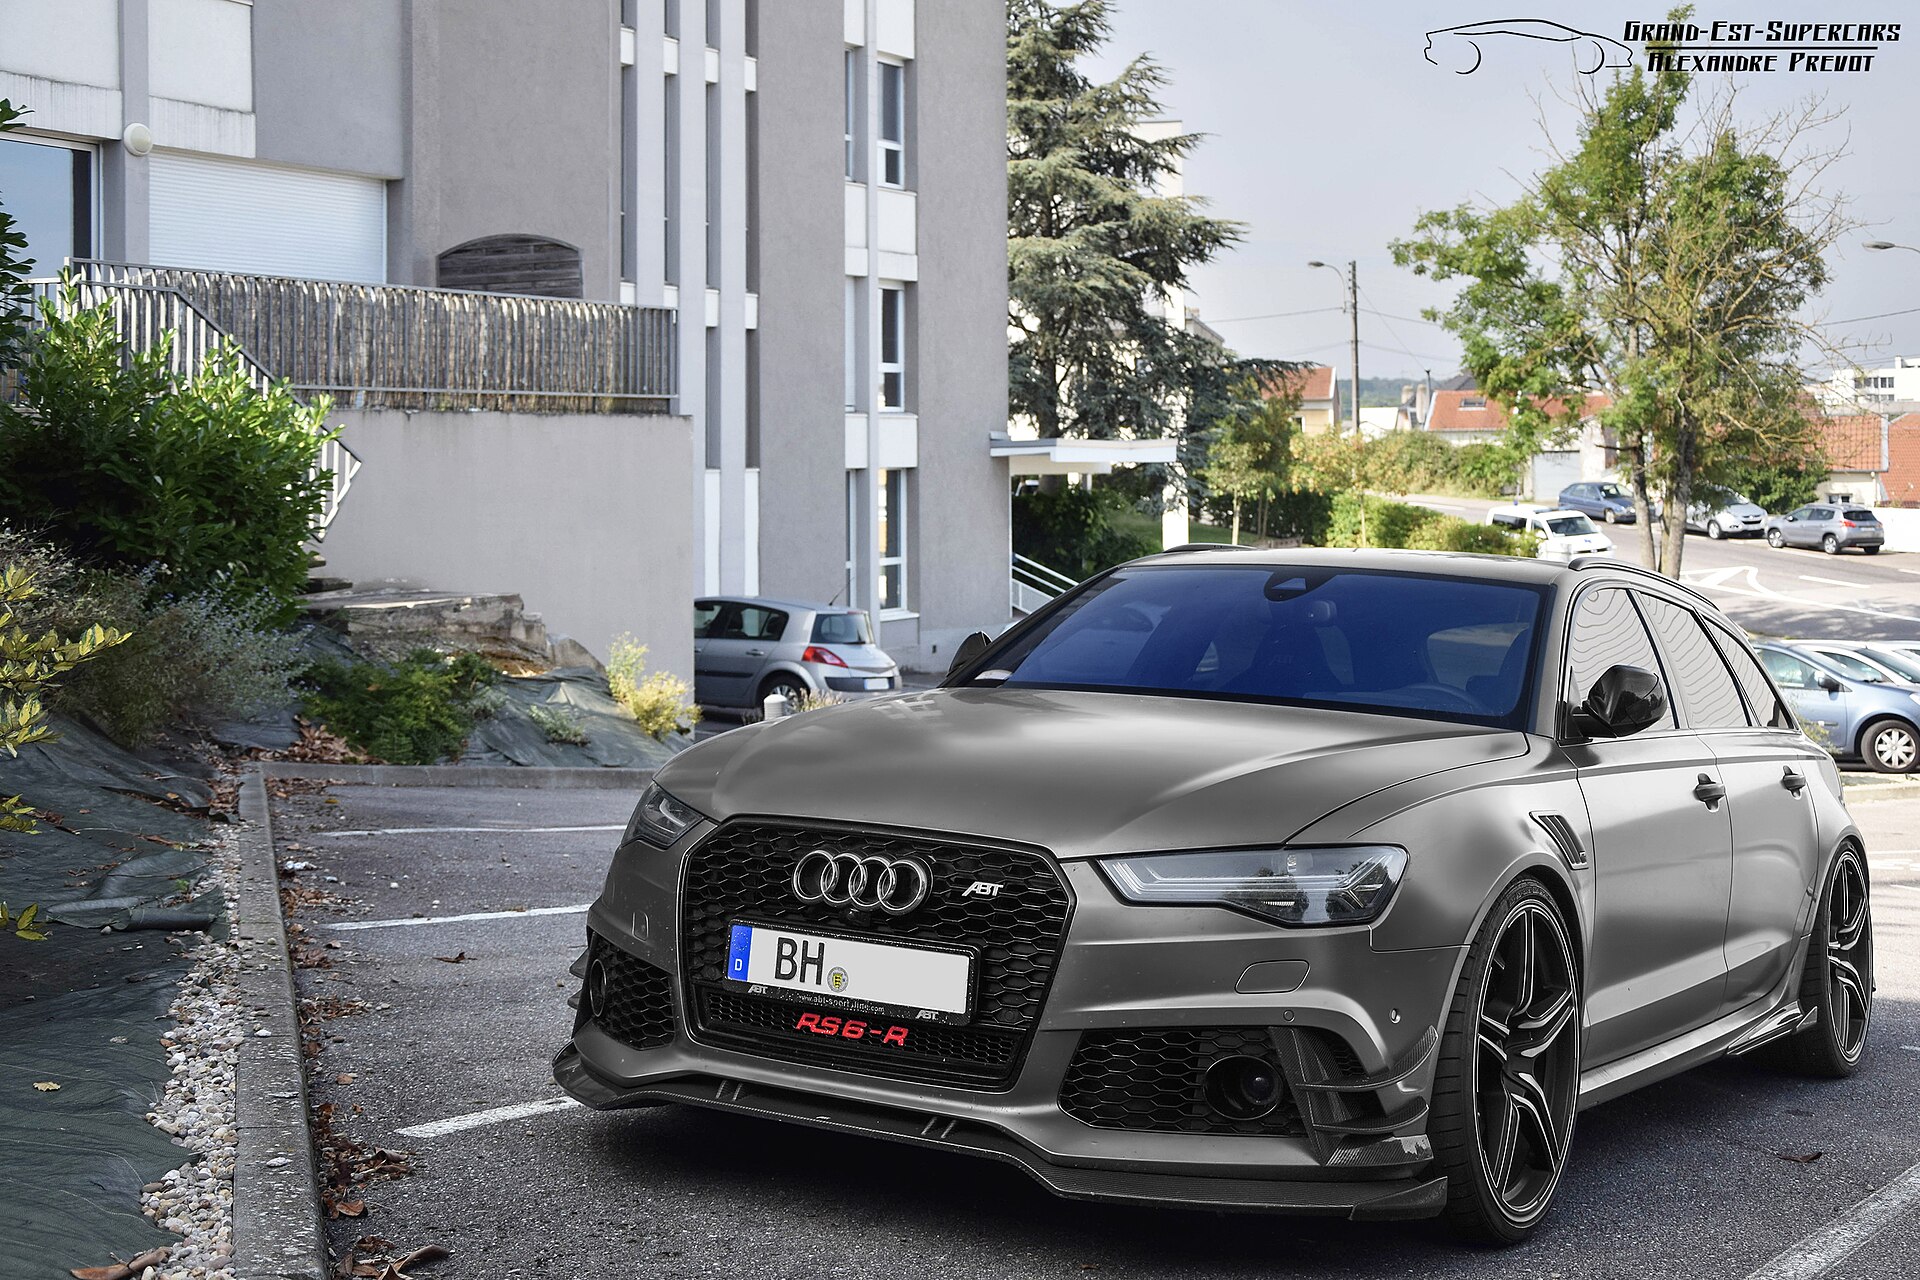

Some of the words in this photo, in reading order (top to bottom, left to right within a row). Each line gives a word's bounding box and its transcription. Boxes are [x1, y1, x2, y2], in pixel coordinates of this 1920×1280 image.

[961, 881, 1004, 897] ABT
[734, 958, 743, 971] D
[774, 936, 825, 986] BH
[747, 984, 769, 995] ABT
[915, 1009, 940, 1021] ABT
[795, 1012, 909, 1046] RS6-R
